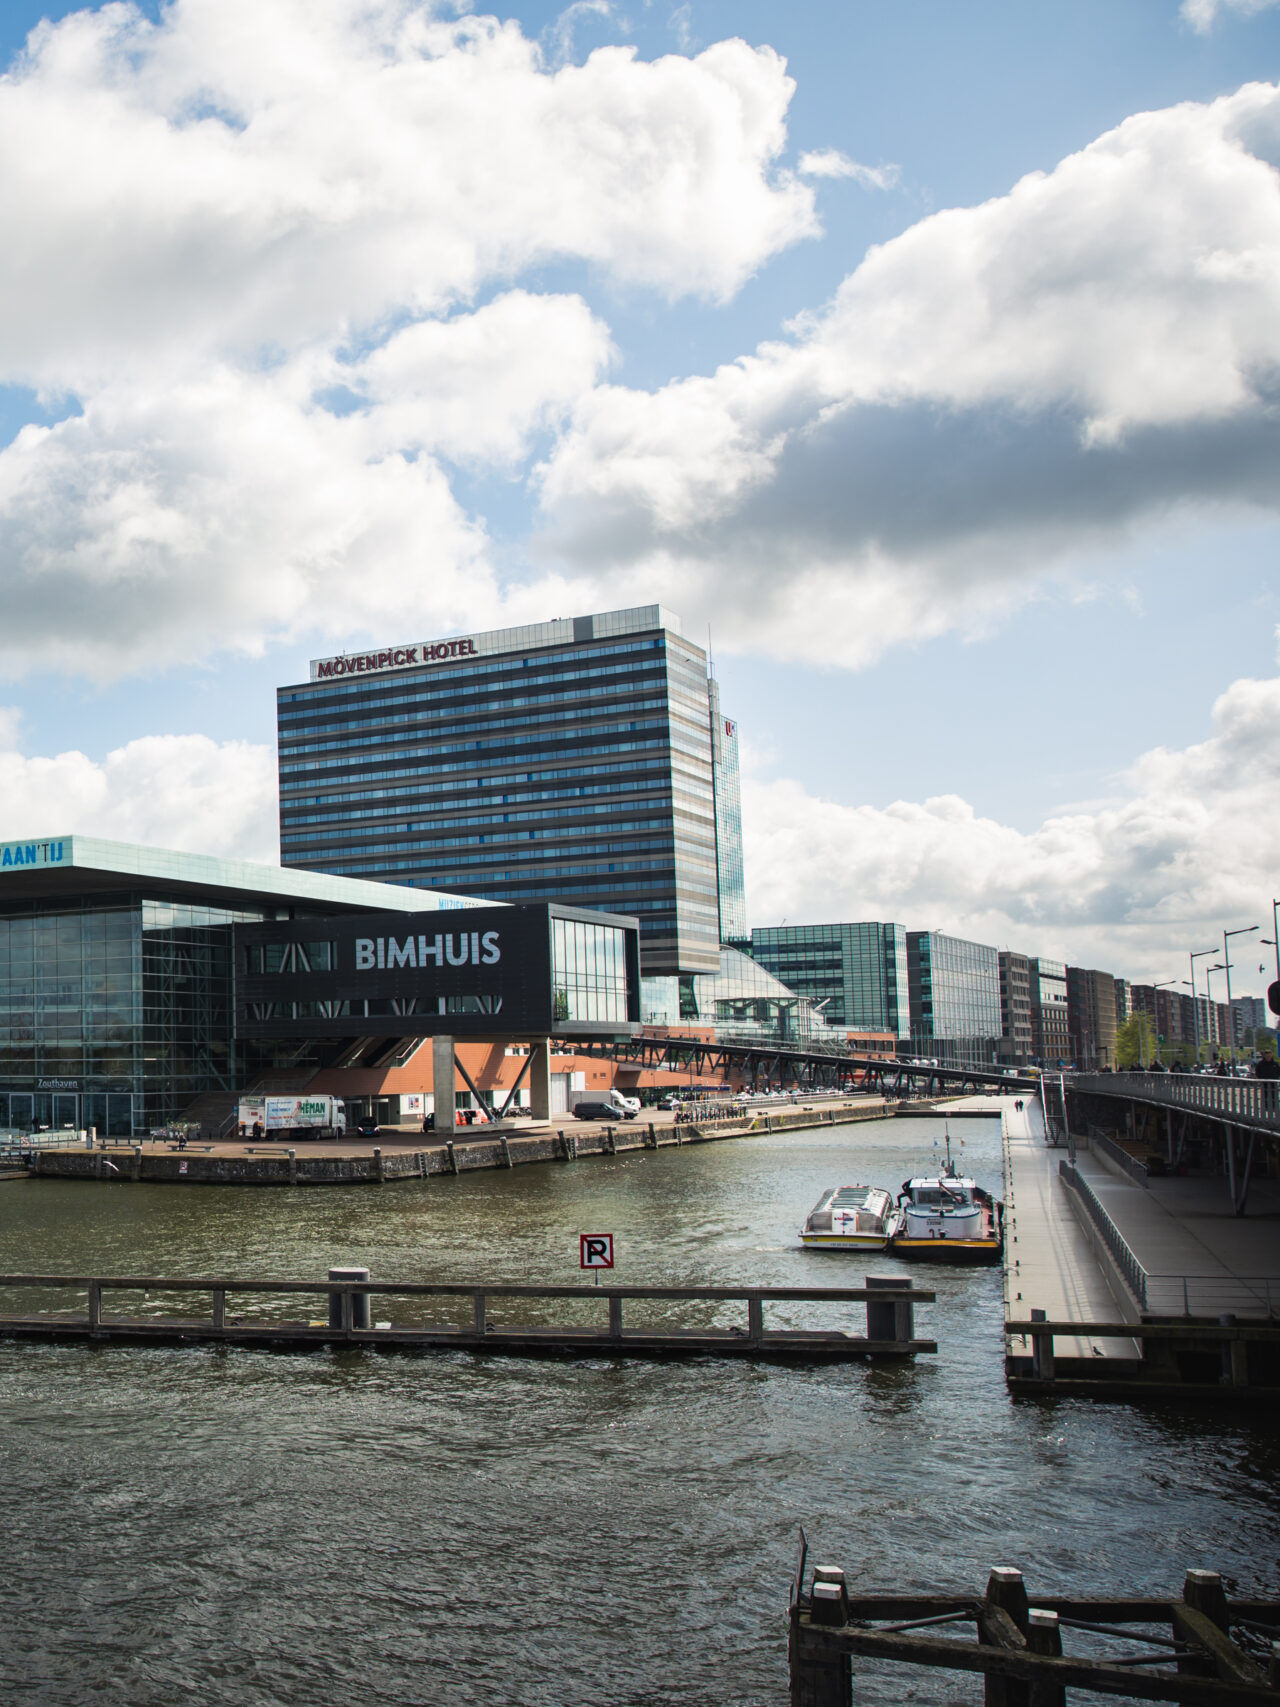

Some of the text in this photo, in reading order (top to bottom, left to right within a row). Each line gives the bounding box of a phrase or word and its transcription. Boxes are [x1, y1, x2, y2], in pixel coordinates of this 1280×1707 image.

[423, 639, 478, 662] HOTEL
[355, 931, 501, 970] BIMHUIS
[38, 1078, 78, 1088] Zouthaven
